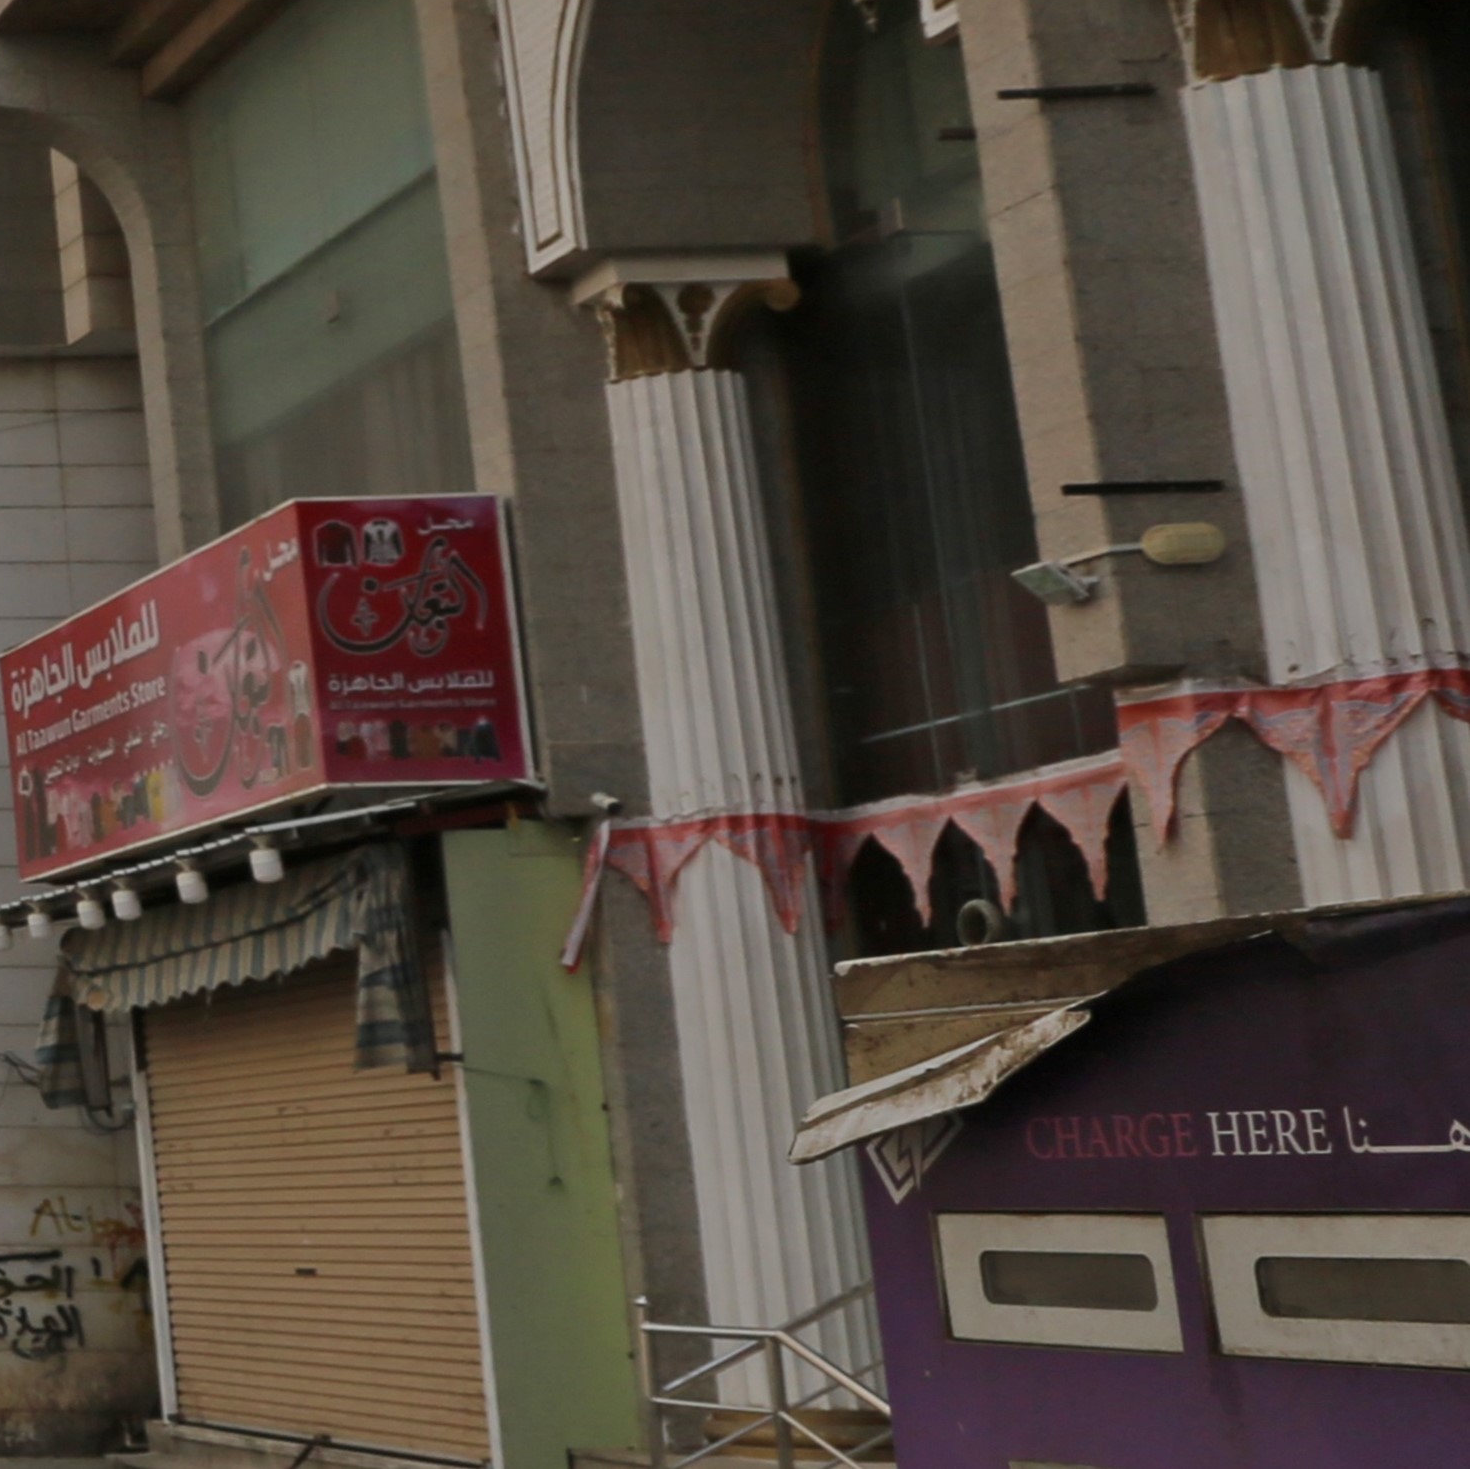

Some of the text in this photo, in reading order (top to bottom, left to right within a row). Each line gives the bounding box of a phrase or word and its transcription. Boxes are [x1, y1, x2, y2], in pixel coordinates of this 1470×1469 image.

[11, 599, 159, 719] للملابس الجاهزة
[130, 676, 166, 708] Store
[1026, 1108, 1332, 1160] CHARGE HERE
